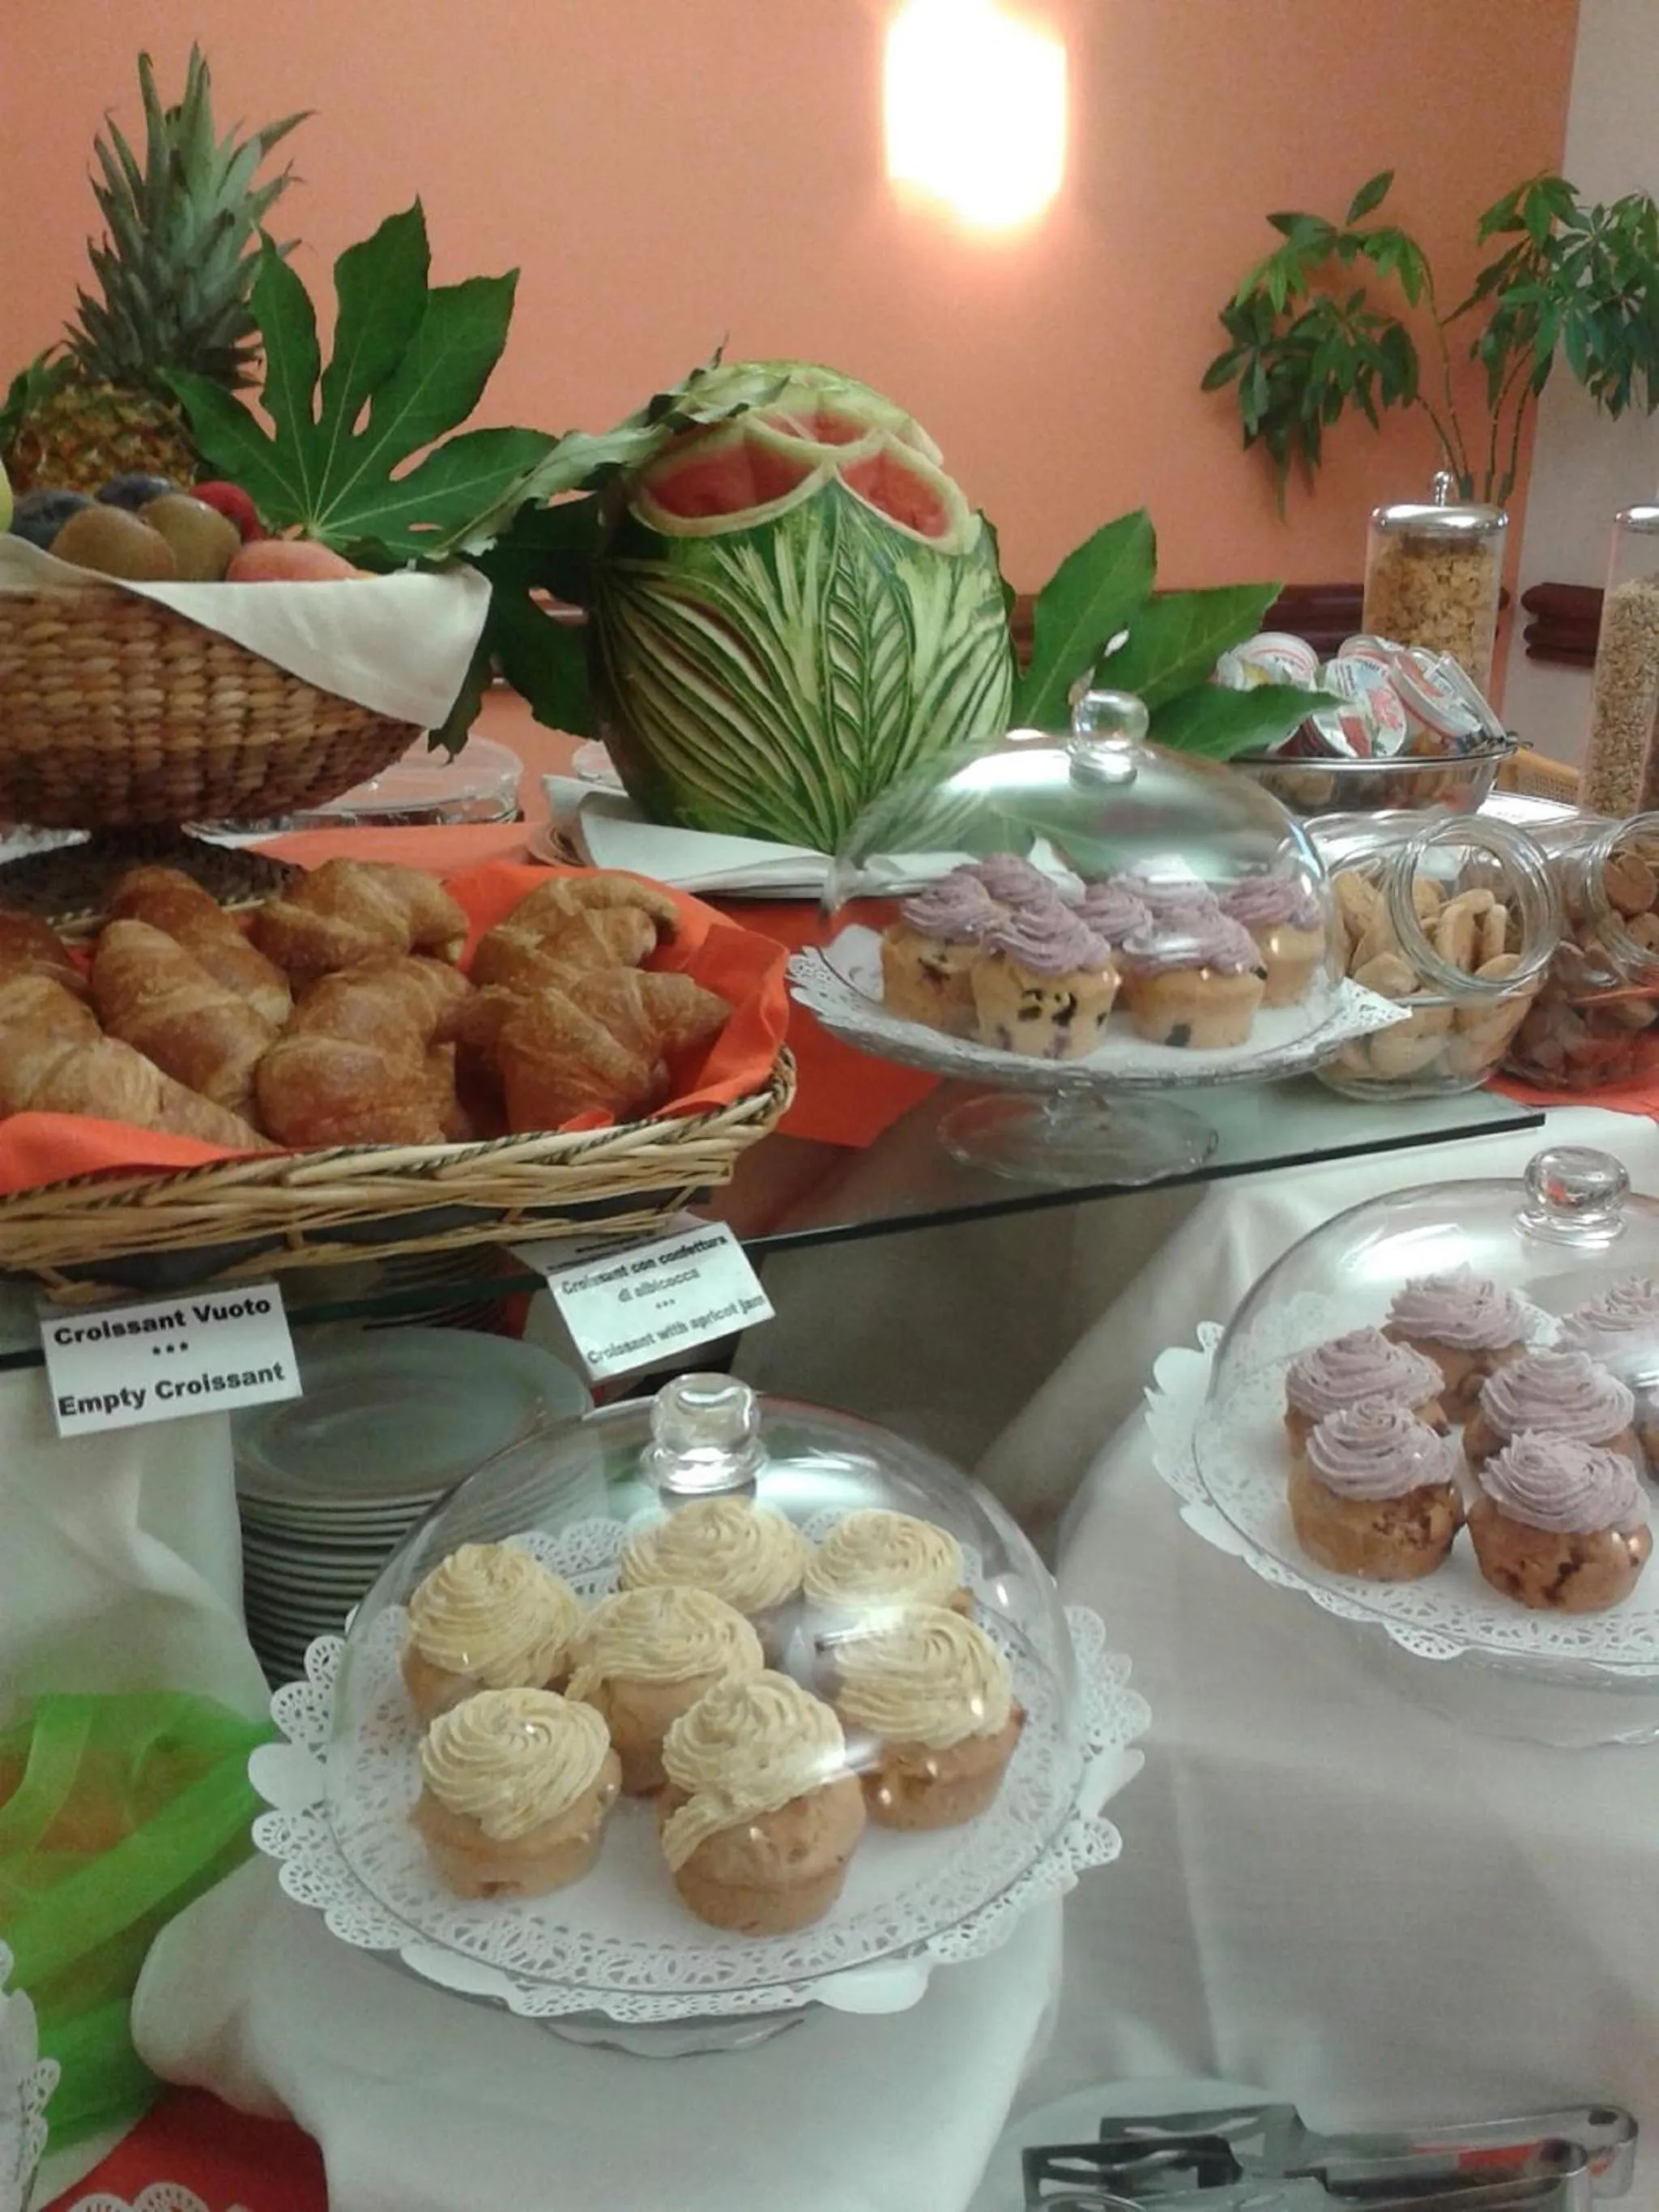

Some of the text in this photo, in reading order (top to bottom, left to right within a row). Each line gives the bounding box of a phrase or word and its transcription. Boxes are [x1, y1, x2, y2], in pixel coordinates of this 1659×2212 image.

[562, 1264, 629, 1296] Croissant
[631, 1258, 656, 1275] con
[659, 1234, 728, 1264] confettura
[634, 1268, 700, 1297] albicocca
[53, 1298, 271, 1345] Croissant Vuoto
[587, 1330, 655, 1364] Croissant
[657, 1322, 688, 1342] with
[689, 1303, 739, 1330] apricot
[58, 1362, 284, 1416] Empty Croissant
